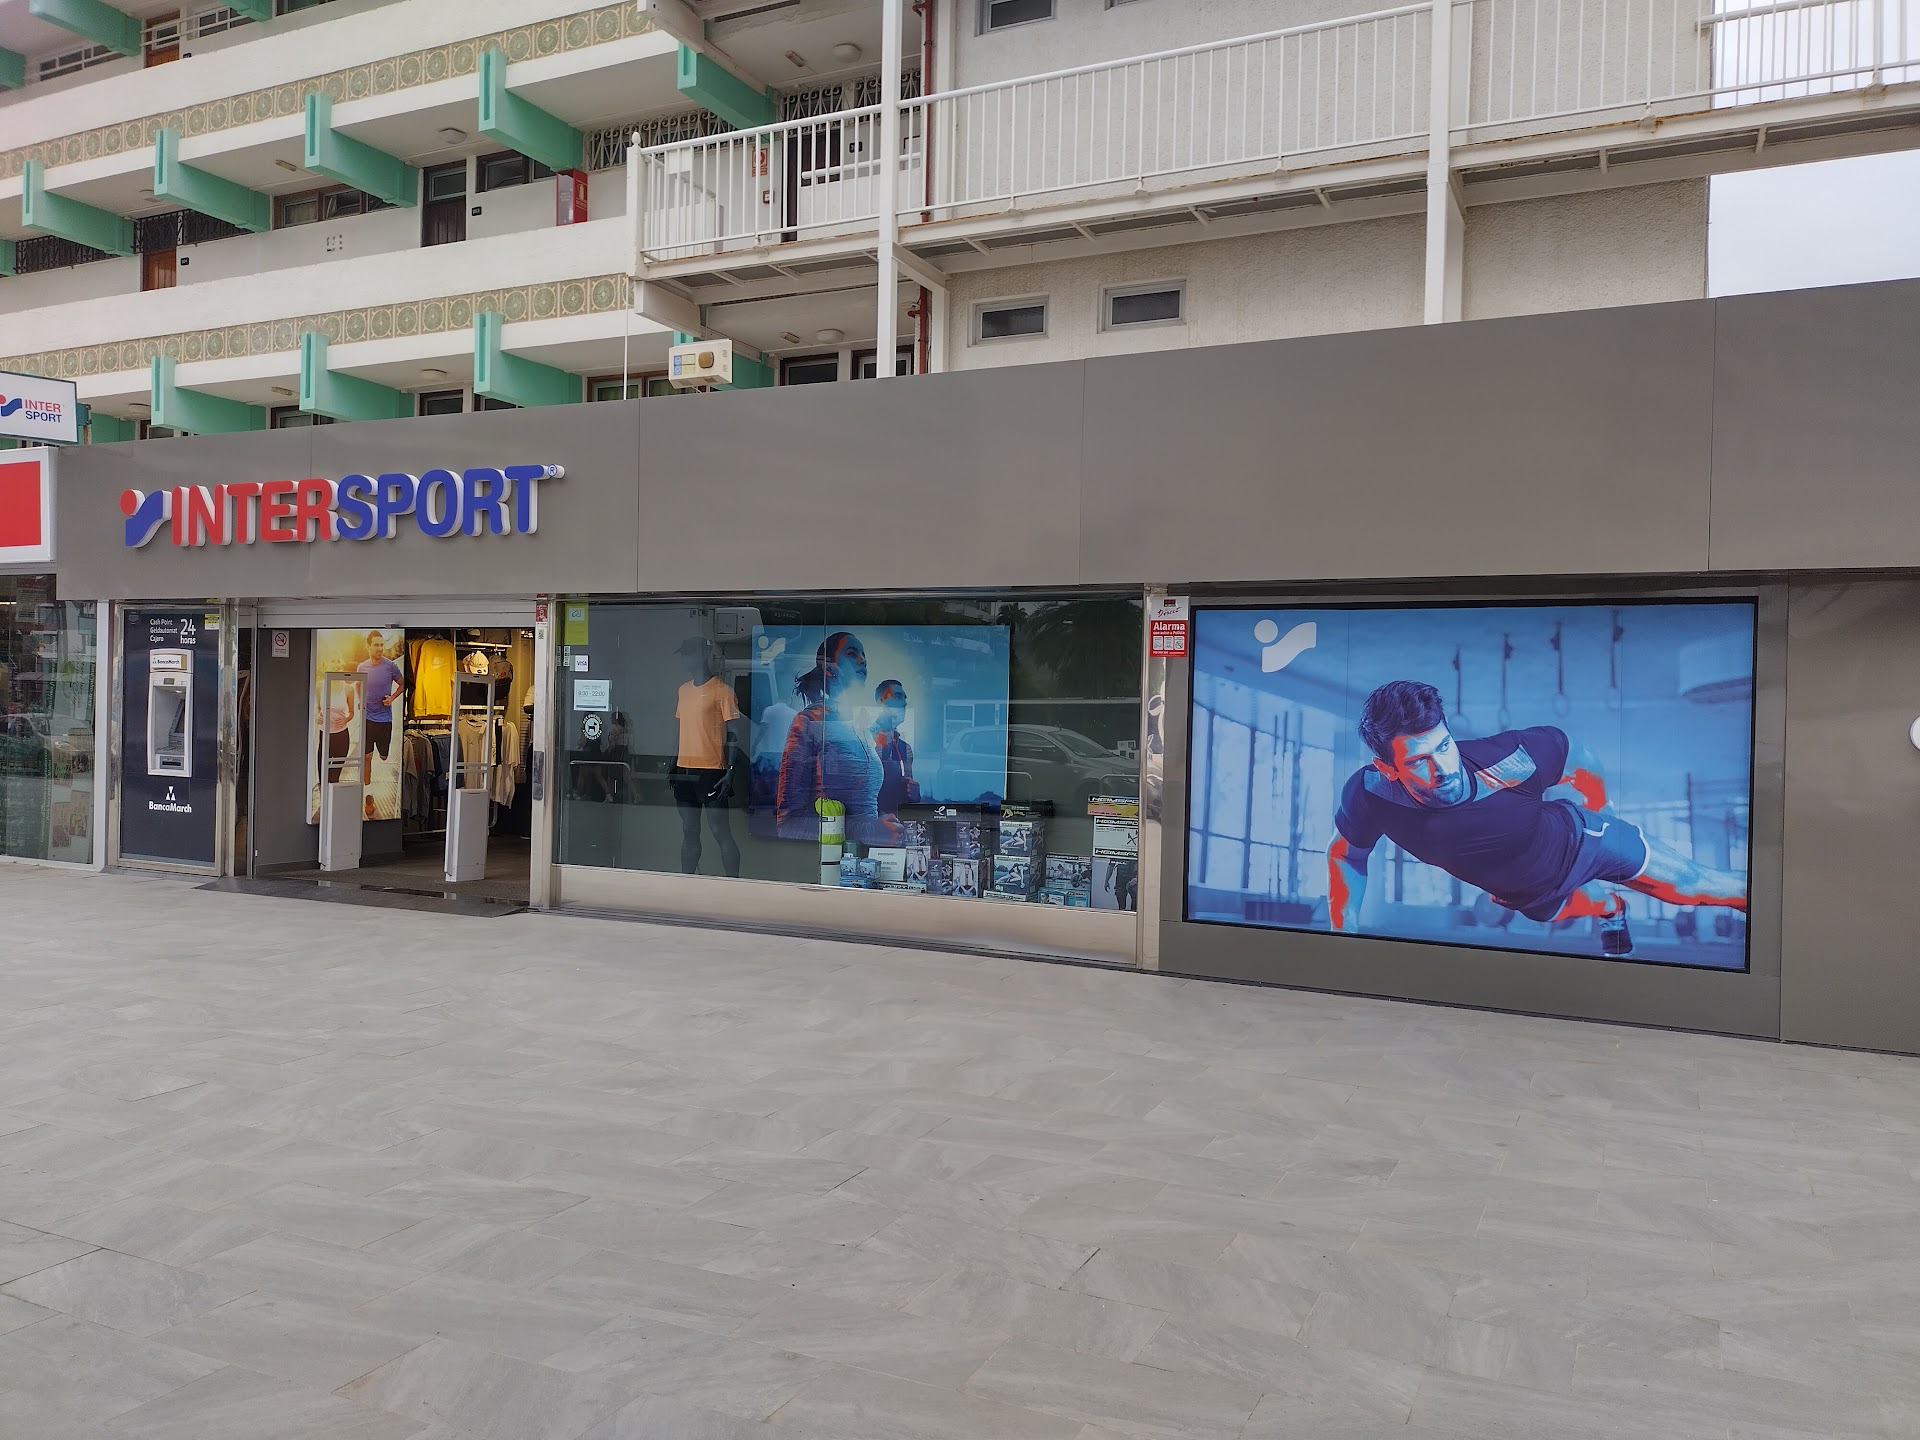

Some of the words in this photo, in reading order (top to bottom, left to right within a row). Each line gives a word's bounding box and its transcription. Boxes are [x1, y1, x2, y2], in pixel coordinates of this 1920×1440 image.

[25, 399, 61, 413] INTER
[25, 410, 62, 423] SPORT
[149, 618, 160, 626] Cash
[180, 618, 196, 636] 24
[1153, 622, 1185, 631] Alarma
[180, 635, 196, 645] horas
[148, 801, 192, 813] BancaMarch
